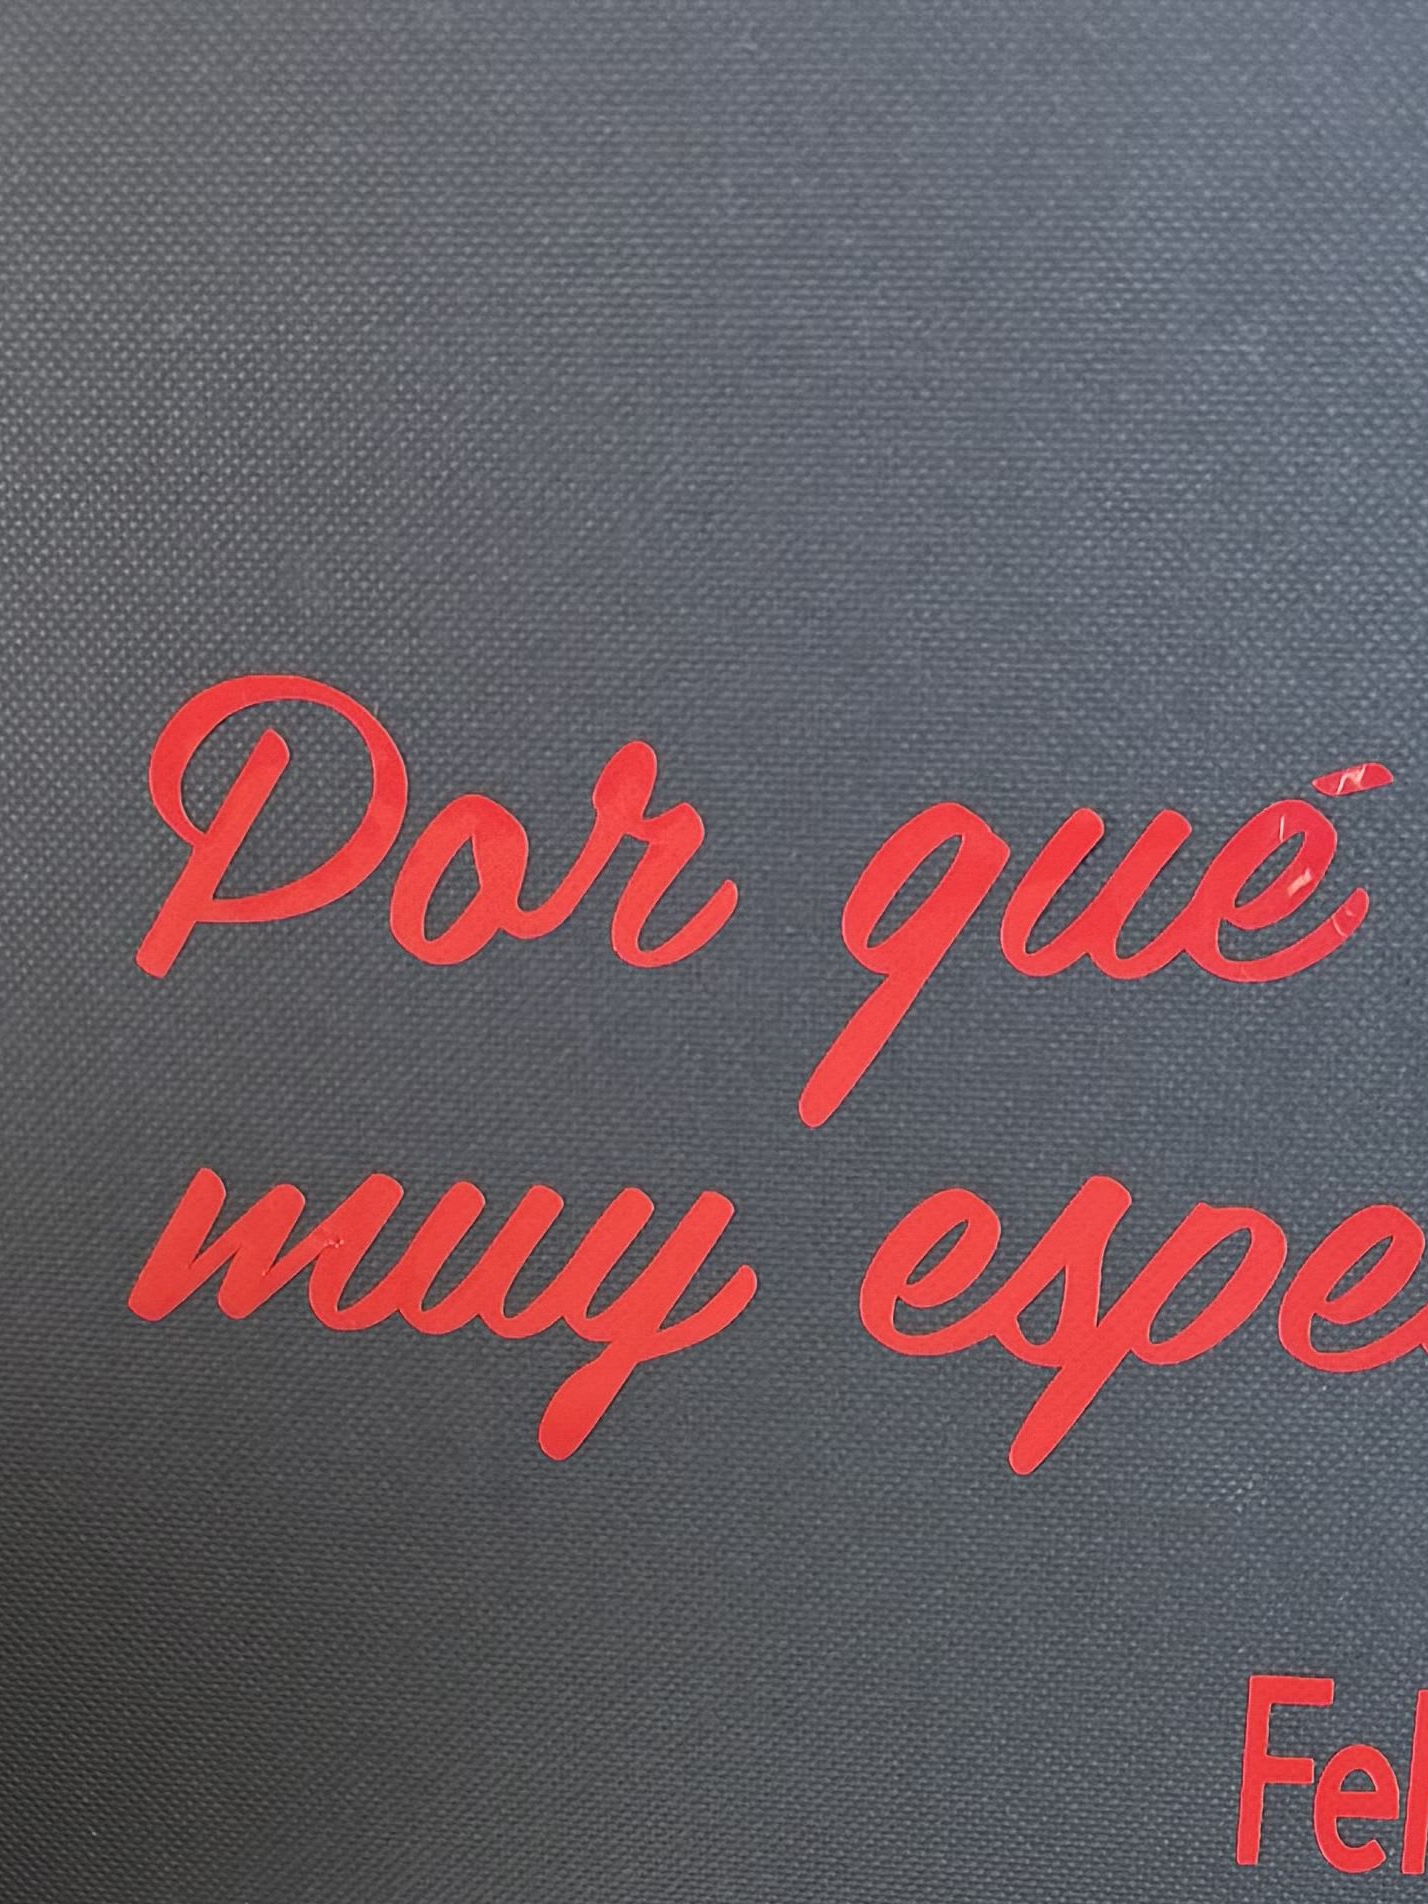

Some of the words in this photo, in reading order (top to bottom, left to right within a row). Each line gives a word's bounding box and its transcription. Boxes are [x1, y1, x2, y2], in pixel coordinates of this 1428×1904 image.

[135, 674, 738, 978] Por
[798, 762, 1394, 1128] qué
[127, 1167, 758, 1461] muy
